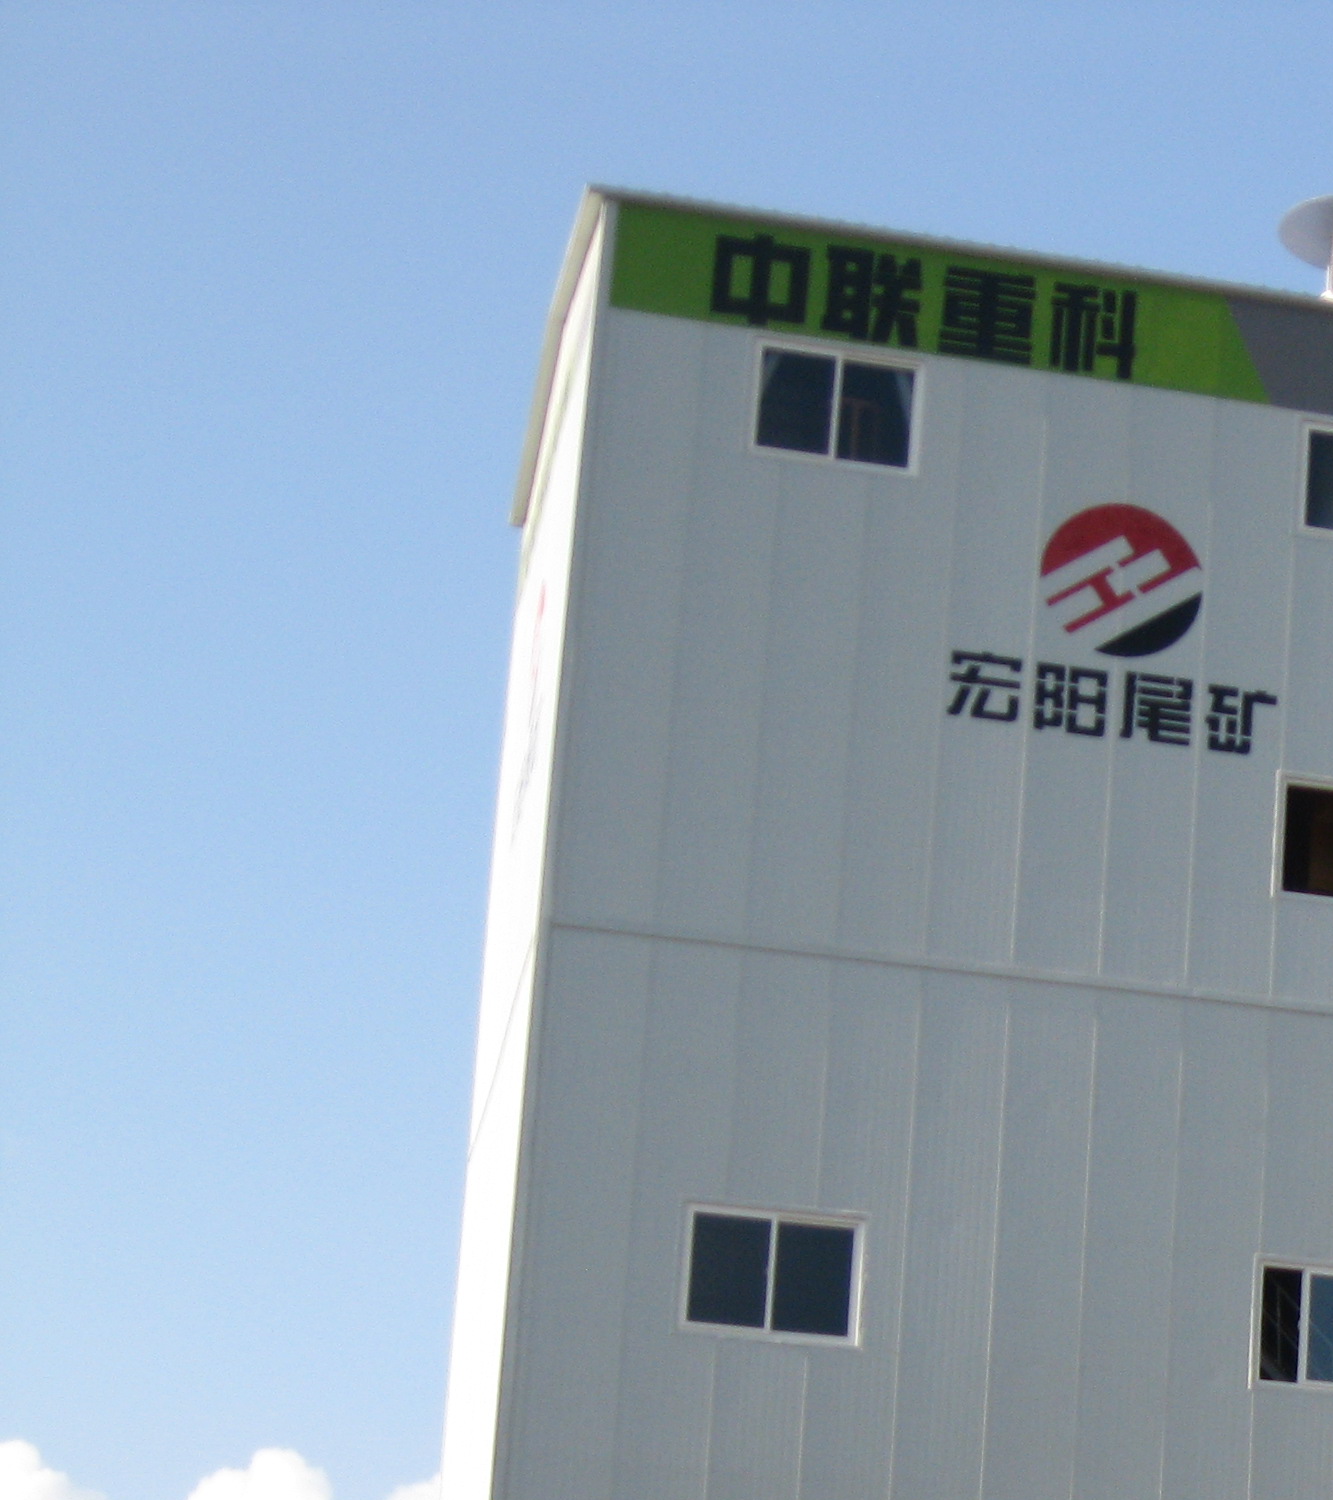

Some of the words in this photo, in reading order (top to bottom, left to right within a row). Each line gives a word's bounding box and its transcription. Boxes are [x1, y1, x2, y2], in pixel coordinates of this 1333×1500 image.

[709, 233, 1138, 380] 中联重科
[946, 649, 1278, 755] 宏阳尾矿
